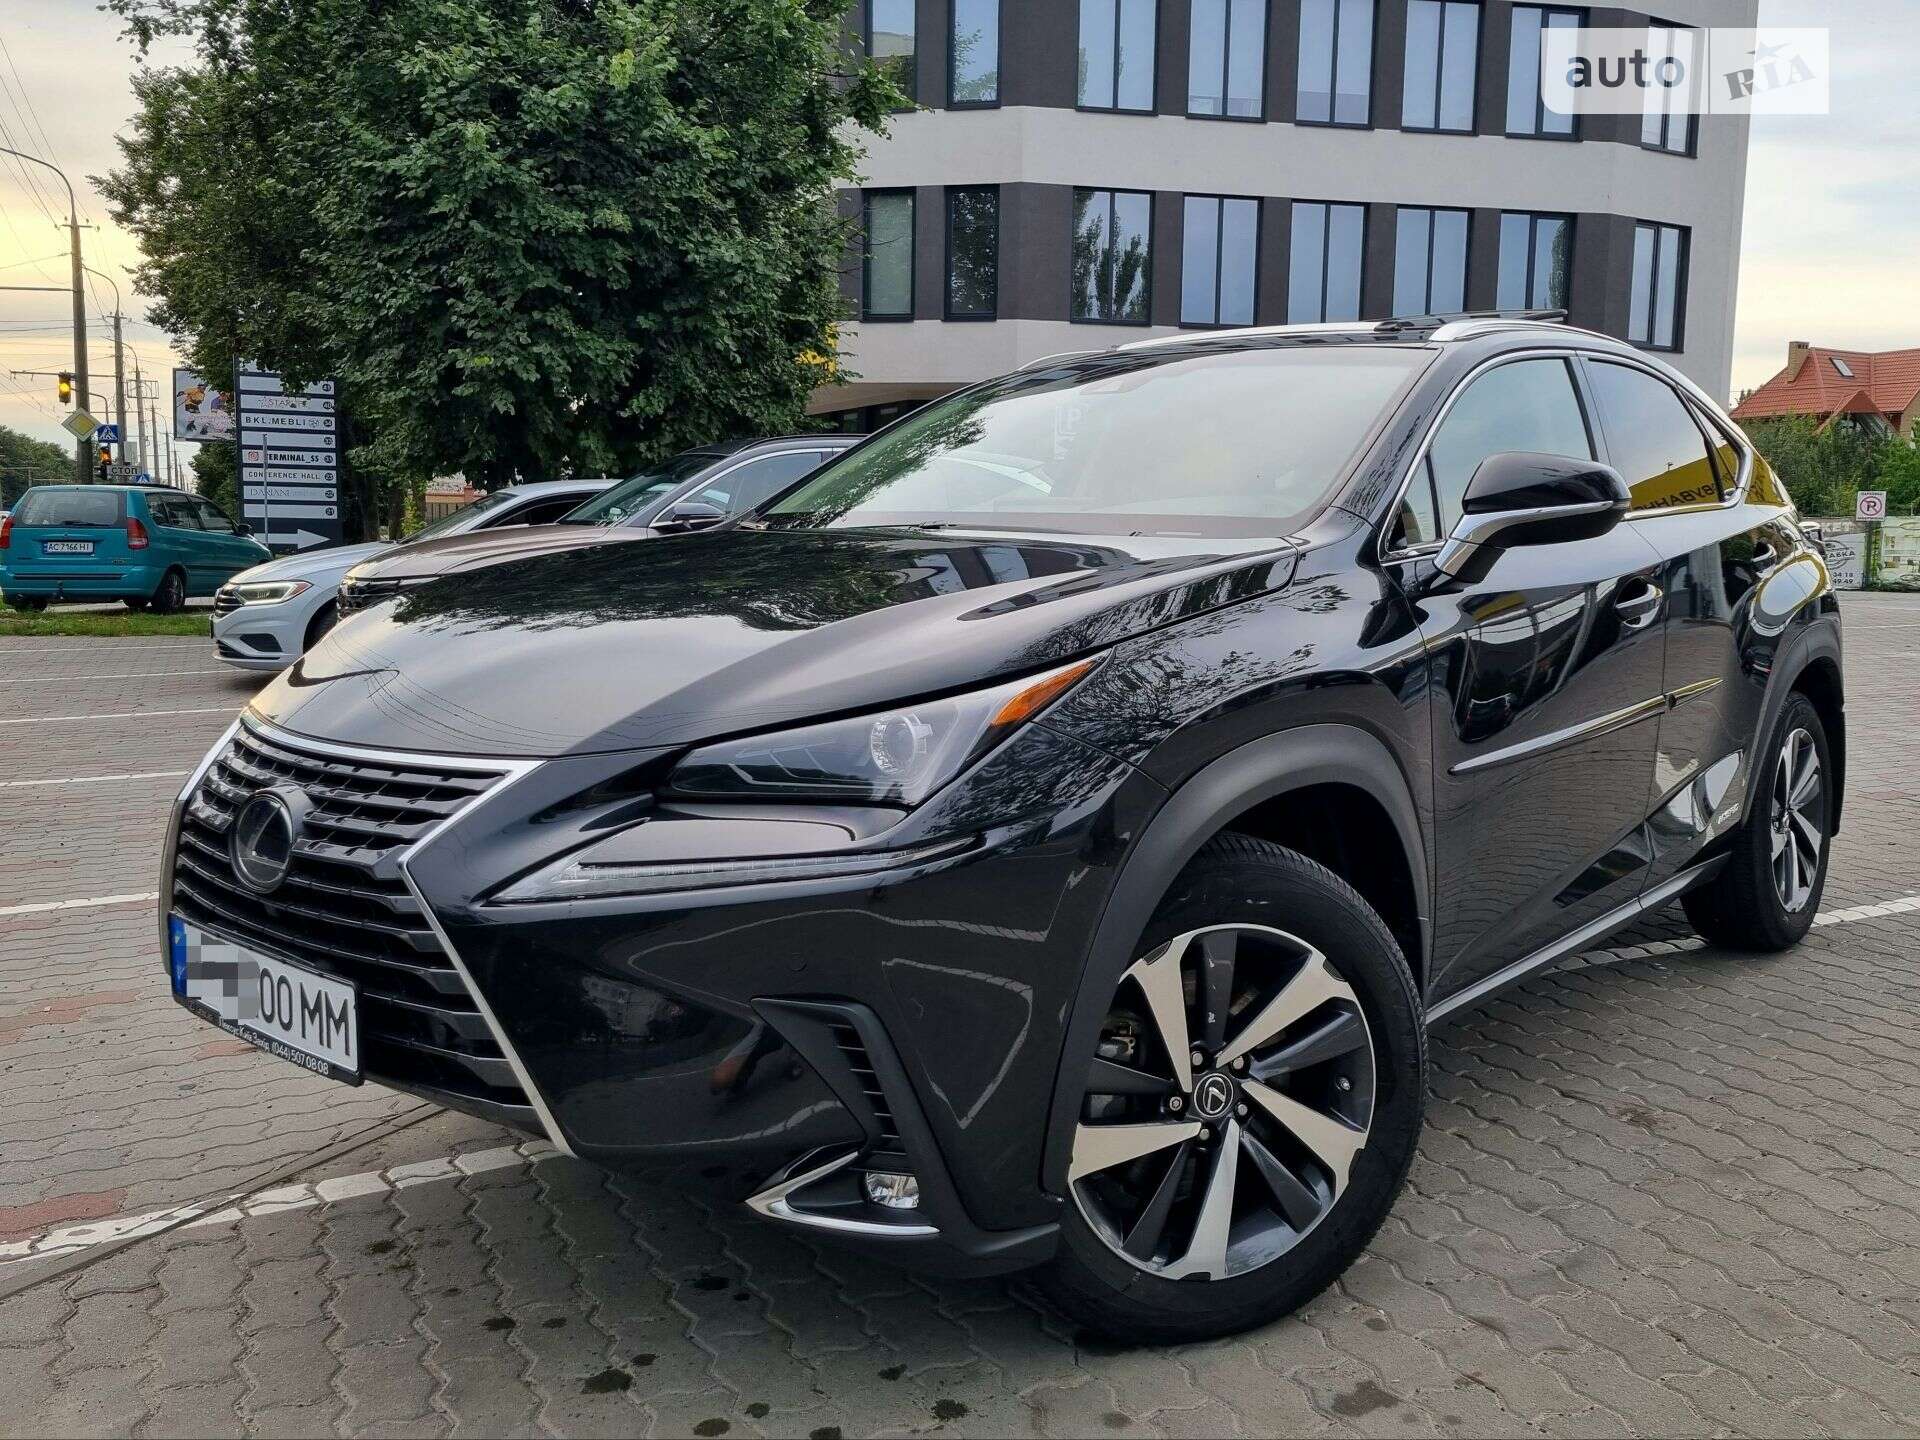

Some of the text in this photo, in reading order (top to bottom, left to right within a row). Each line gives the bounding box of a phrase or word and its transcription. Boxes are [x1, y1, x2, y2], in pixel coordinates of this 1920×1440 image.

[266, 453, 319, 463] ERMINAL_SS
[248, 471, 298, 479] CONERENCE
[299, 982, 350, 1056] MM
[291, 1051, 305, 1066] 507
